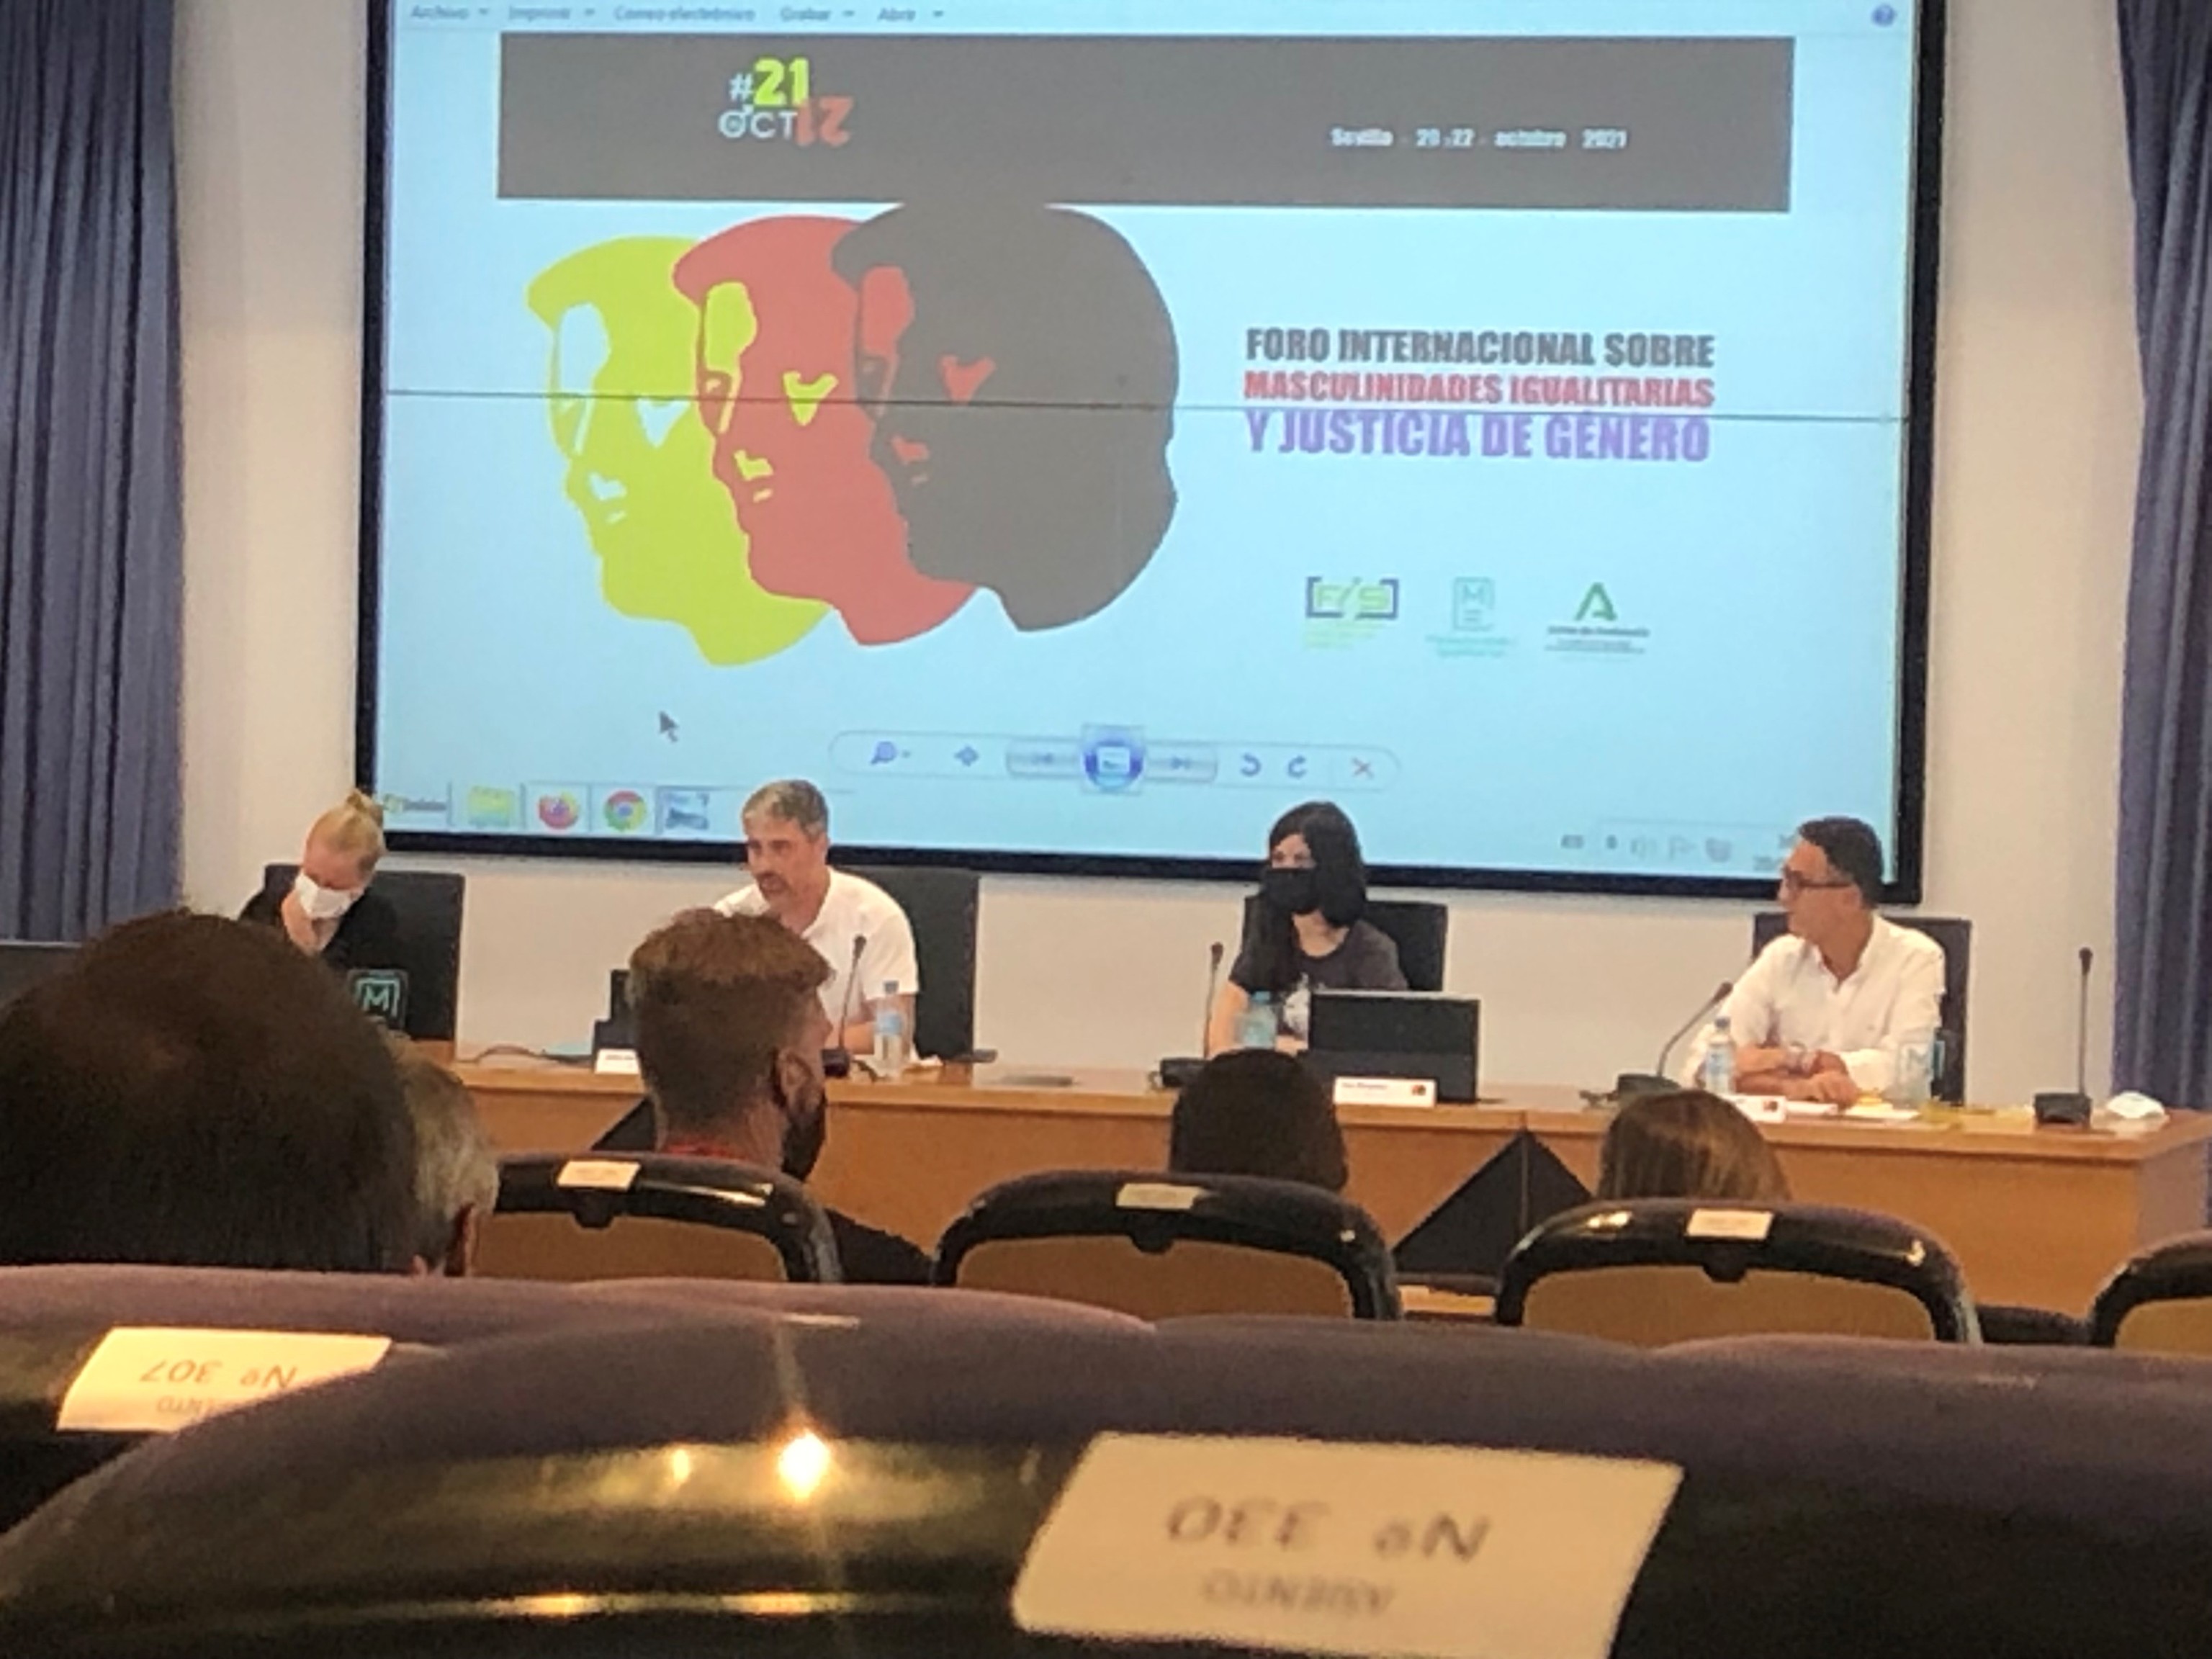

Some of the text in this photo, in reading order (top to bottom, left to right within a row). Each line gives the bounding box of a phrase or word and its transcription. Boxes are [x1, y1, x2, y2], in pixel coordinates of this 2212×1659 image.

[1246, 328, 1715, 368] FORO INTERNACIONAL SOBRE
[1244, 370, 1715, 408] MASCULINIDADES IGUALITARIAS
[1244, 408, 1270, 452] Y
[1277, 408, 1470, 457] JUSTICIA
[1481, 413, 1533, 458] DE
